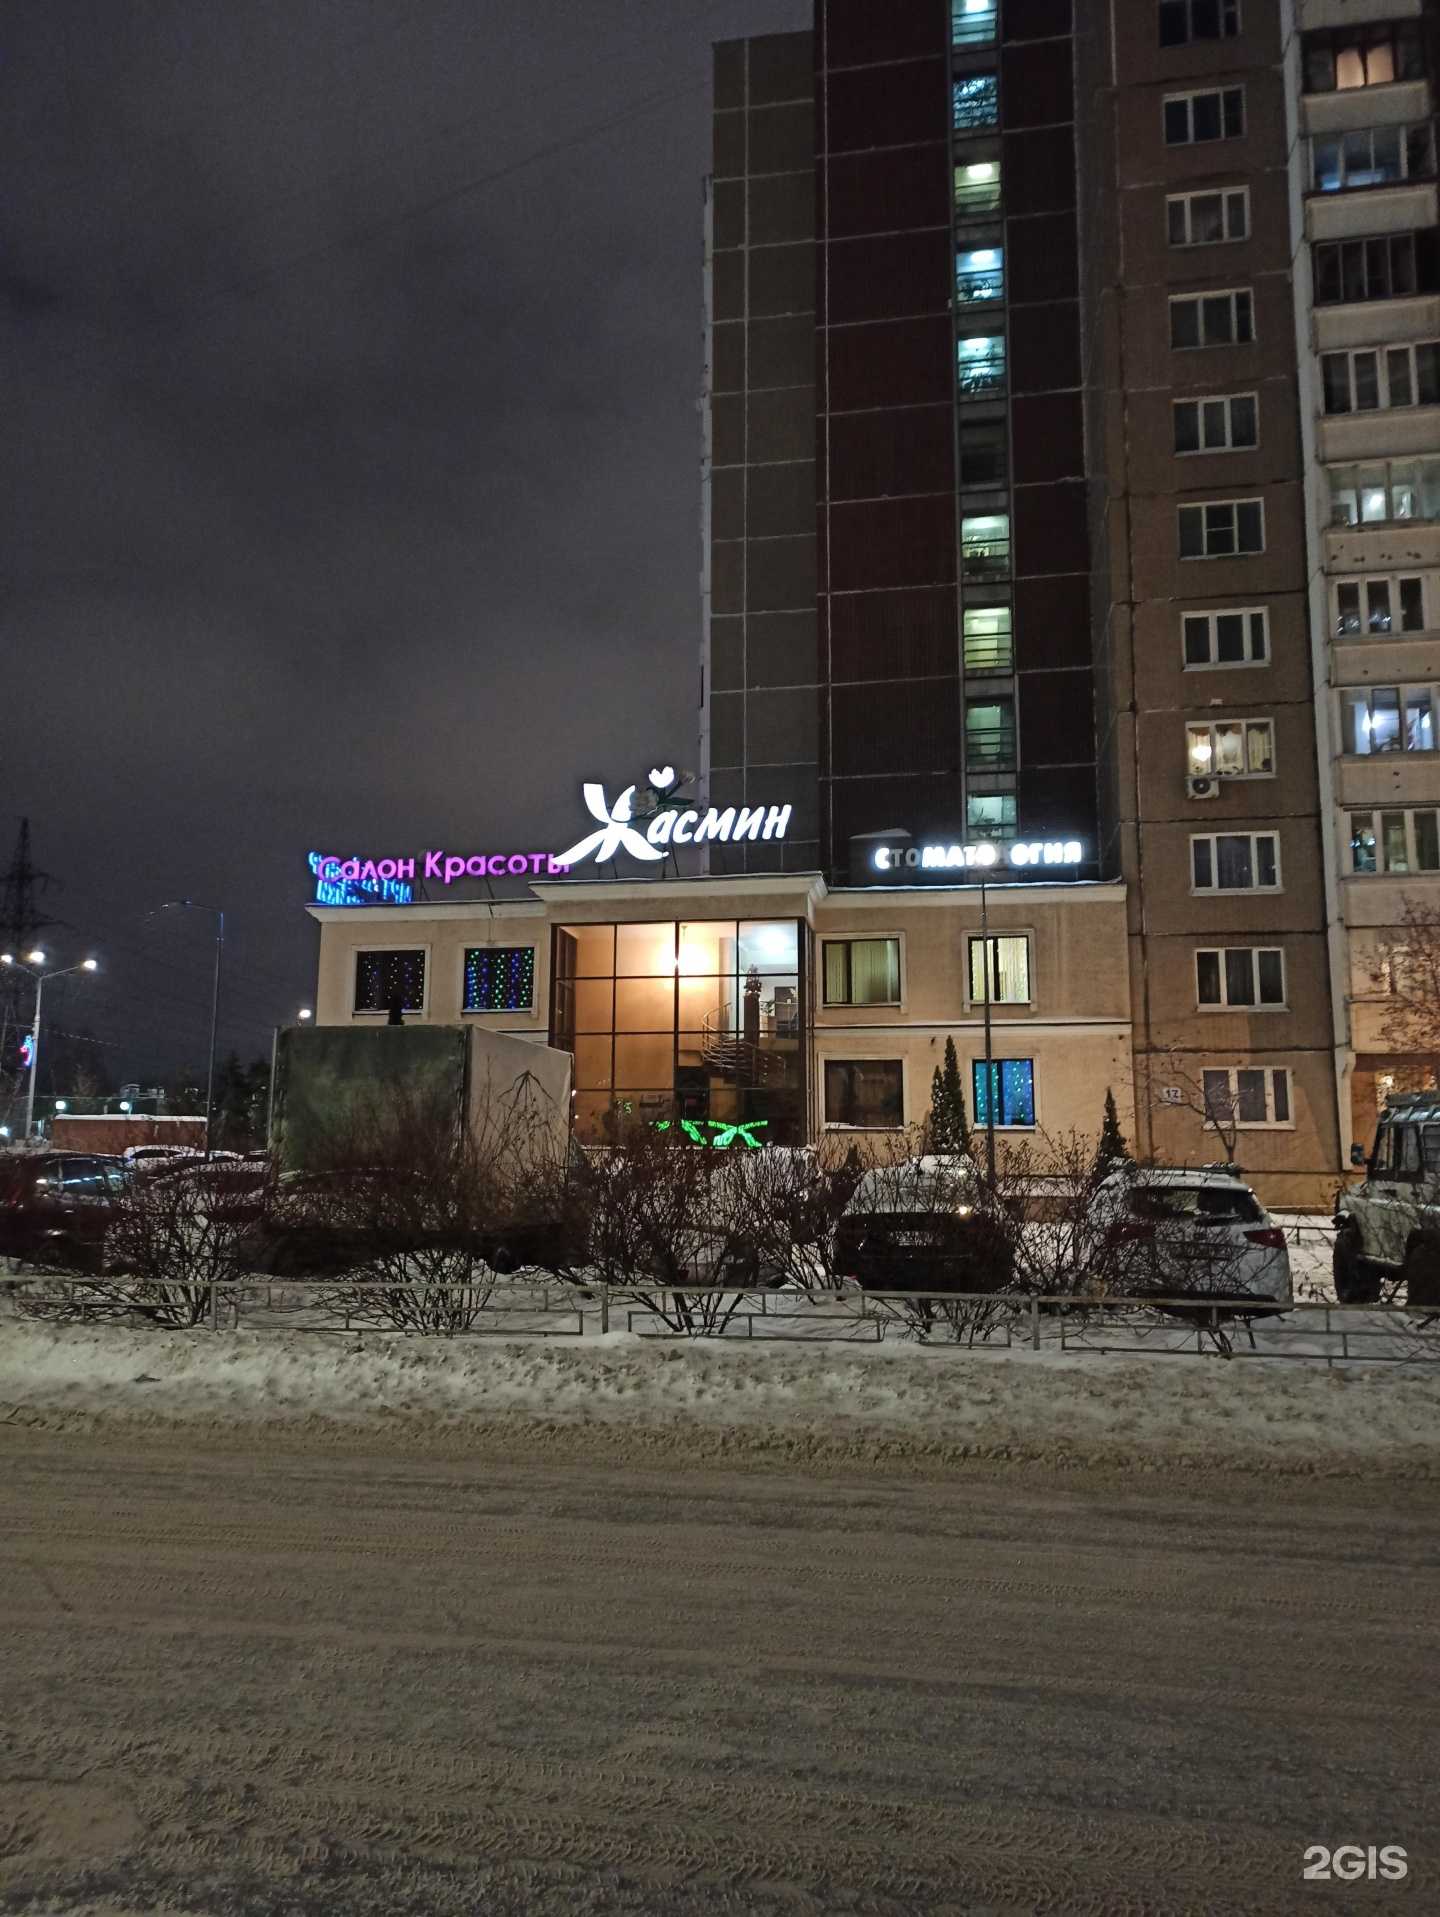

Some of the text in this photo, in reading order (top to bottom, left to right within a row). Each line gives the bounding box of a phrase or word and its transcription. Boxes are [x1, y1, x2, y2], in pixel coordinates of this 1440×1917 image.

[552, 781, 793, 865] Жасмин
[317, 856, 415, 883] Салон
[874, 841, 1083, 870] СТОМАТООГИЯ
